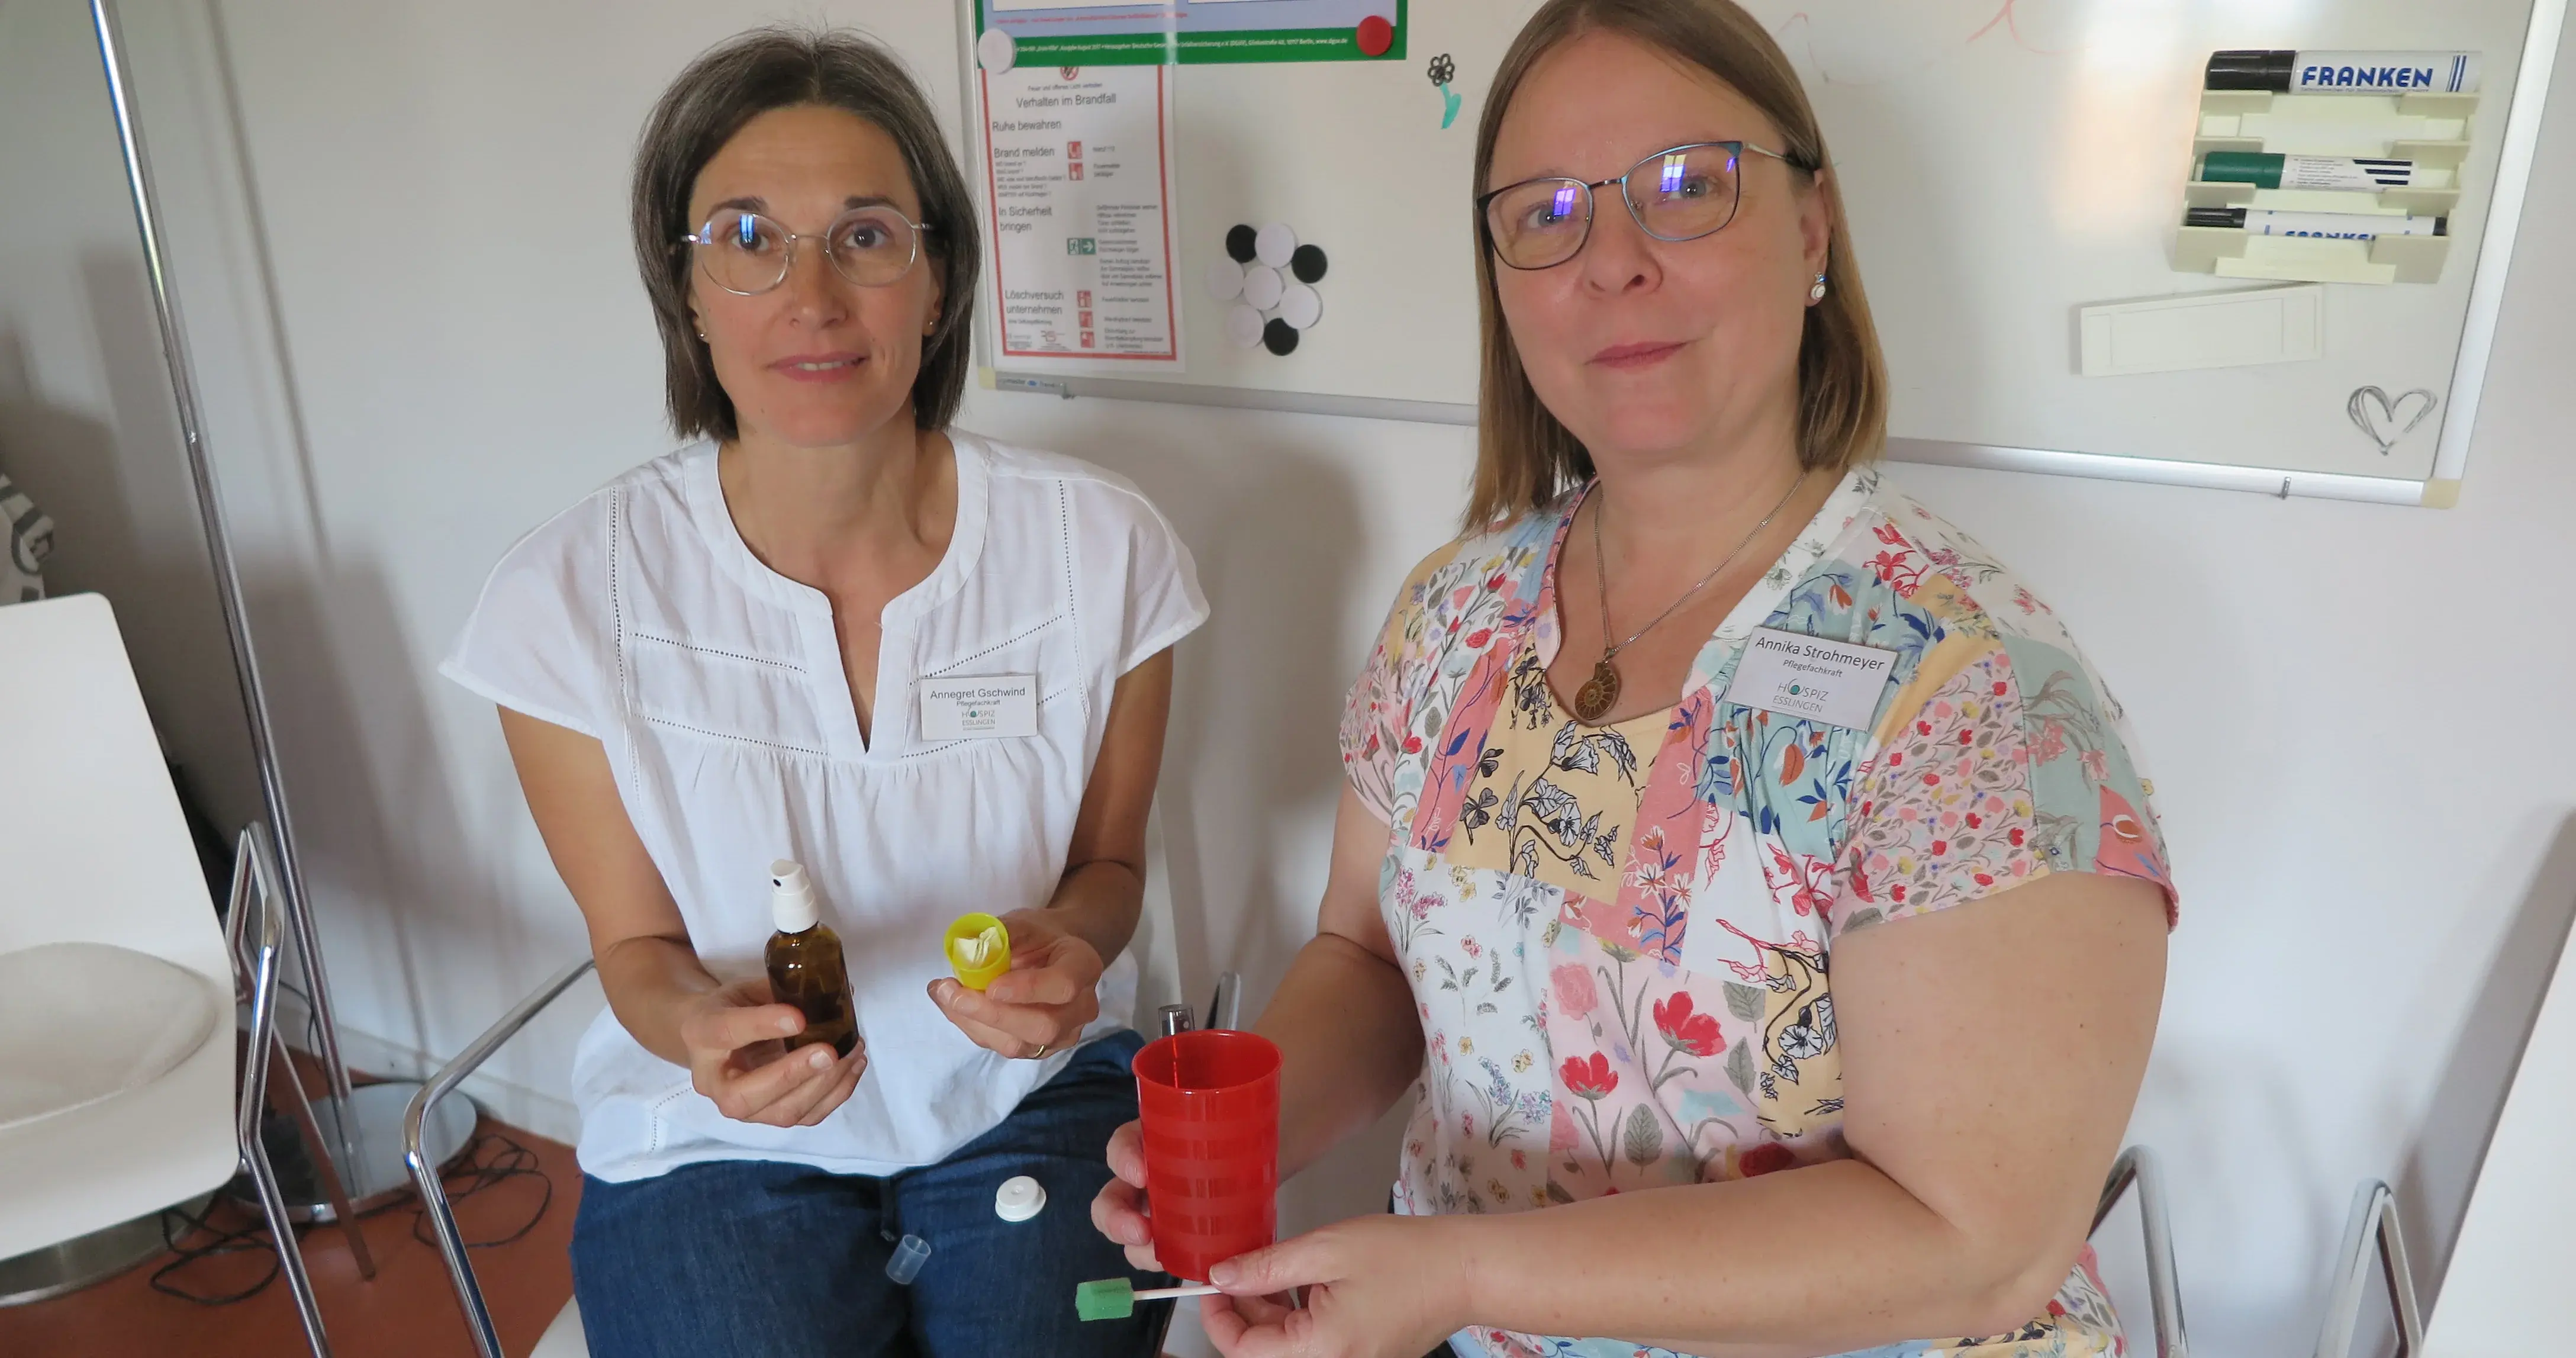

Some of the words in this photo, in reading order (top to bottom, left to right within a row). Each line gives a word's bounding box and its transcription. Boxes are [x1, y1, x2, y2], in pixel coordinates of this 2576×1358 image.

[2301, 66, 2434, 88] FRANKEN
[1016, 96, 1059, 108] Verhalten
[1061, 96, 1073, 107] im
[1075, 93, 1117, 105] Brandfall
[992, 121, 1016, 131] Ruhe
[1017, 120, 1061, 131] bewahren
[994, 147, 1020, 158] Brand
[1022, 147, 1055, 157] melden
[999, 207, 1007, 216] In
[1009, 206, 1052, 217] Sicherheit
[1000, 222, 1032, 234] bringen
[1004, 289, 1064, 301] Löschversuch
[1006, 305, 1063, 315] unternehmen
[1755, 636, 1800, 655] Annika
[1803, 645, 1885, 671] Strohmeyer
[1783, 659, 1843, 678] Pflegefachkraft
[930, 689, 975, 700] Annegret
[978, 687, 1026, 697] Gschwind
[1777, 678, 1830, 702] HOSPIZ
[1773, 694, 1823, 713] ESSLINGEN
